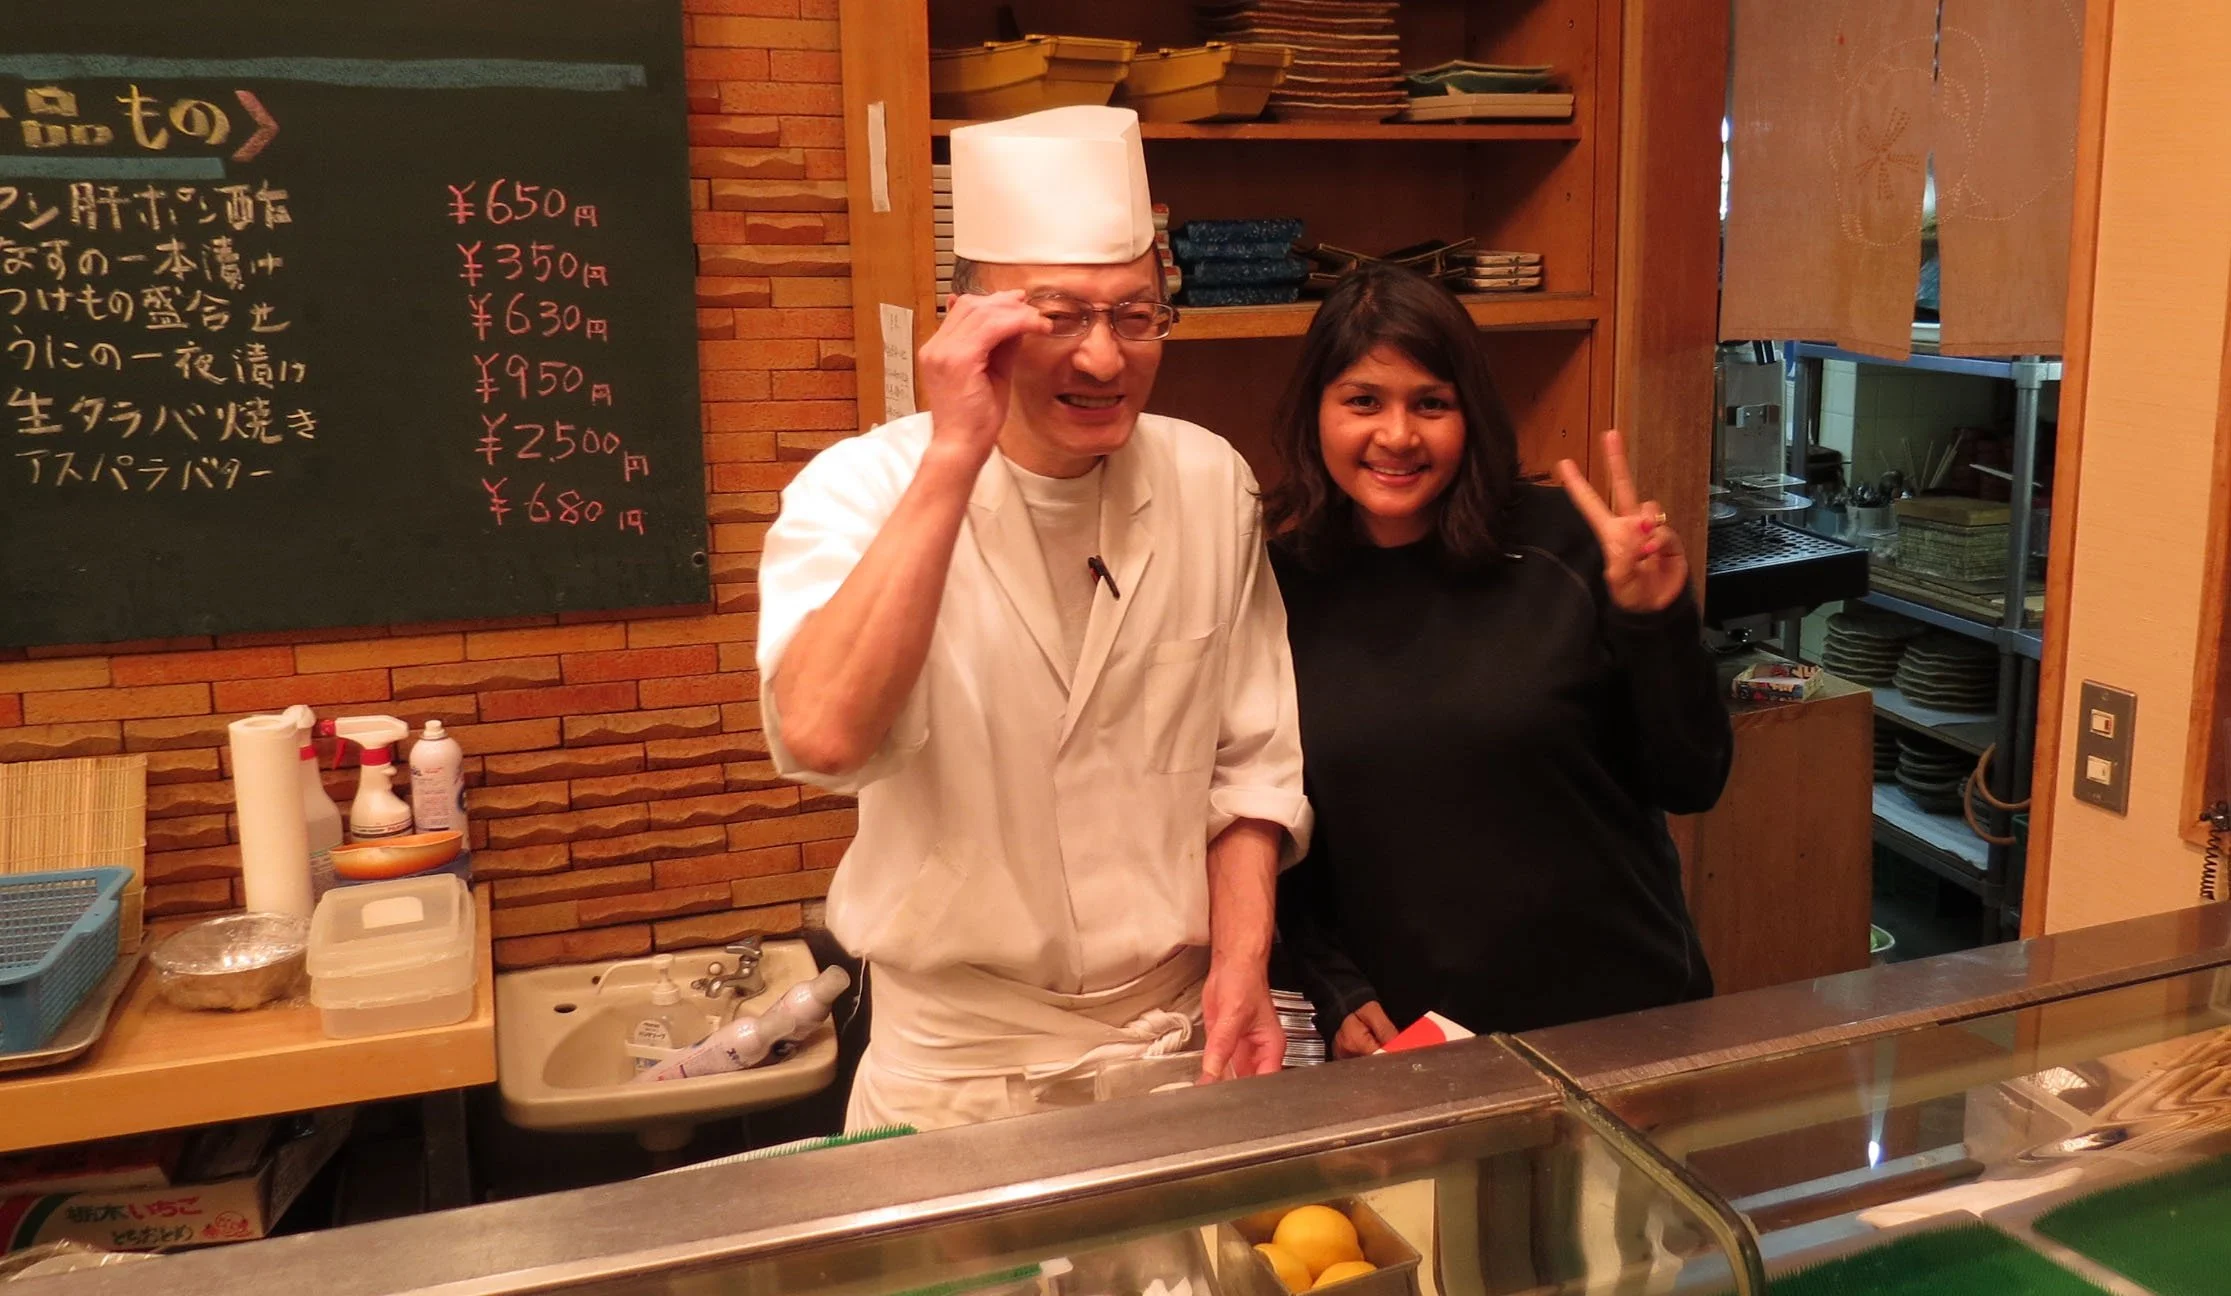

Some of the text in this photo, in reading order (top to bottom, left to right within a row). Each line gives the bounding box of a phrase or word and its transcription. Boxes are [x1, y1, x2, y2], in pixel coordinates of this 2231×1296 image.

[7, 325, 306, 389] うにの一夜漬け
[7, 387, 318, 444] 生タラバ焼き
[15, 449, 273, 491] アスパラバター
